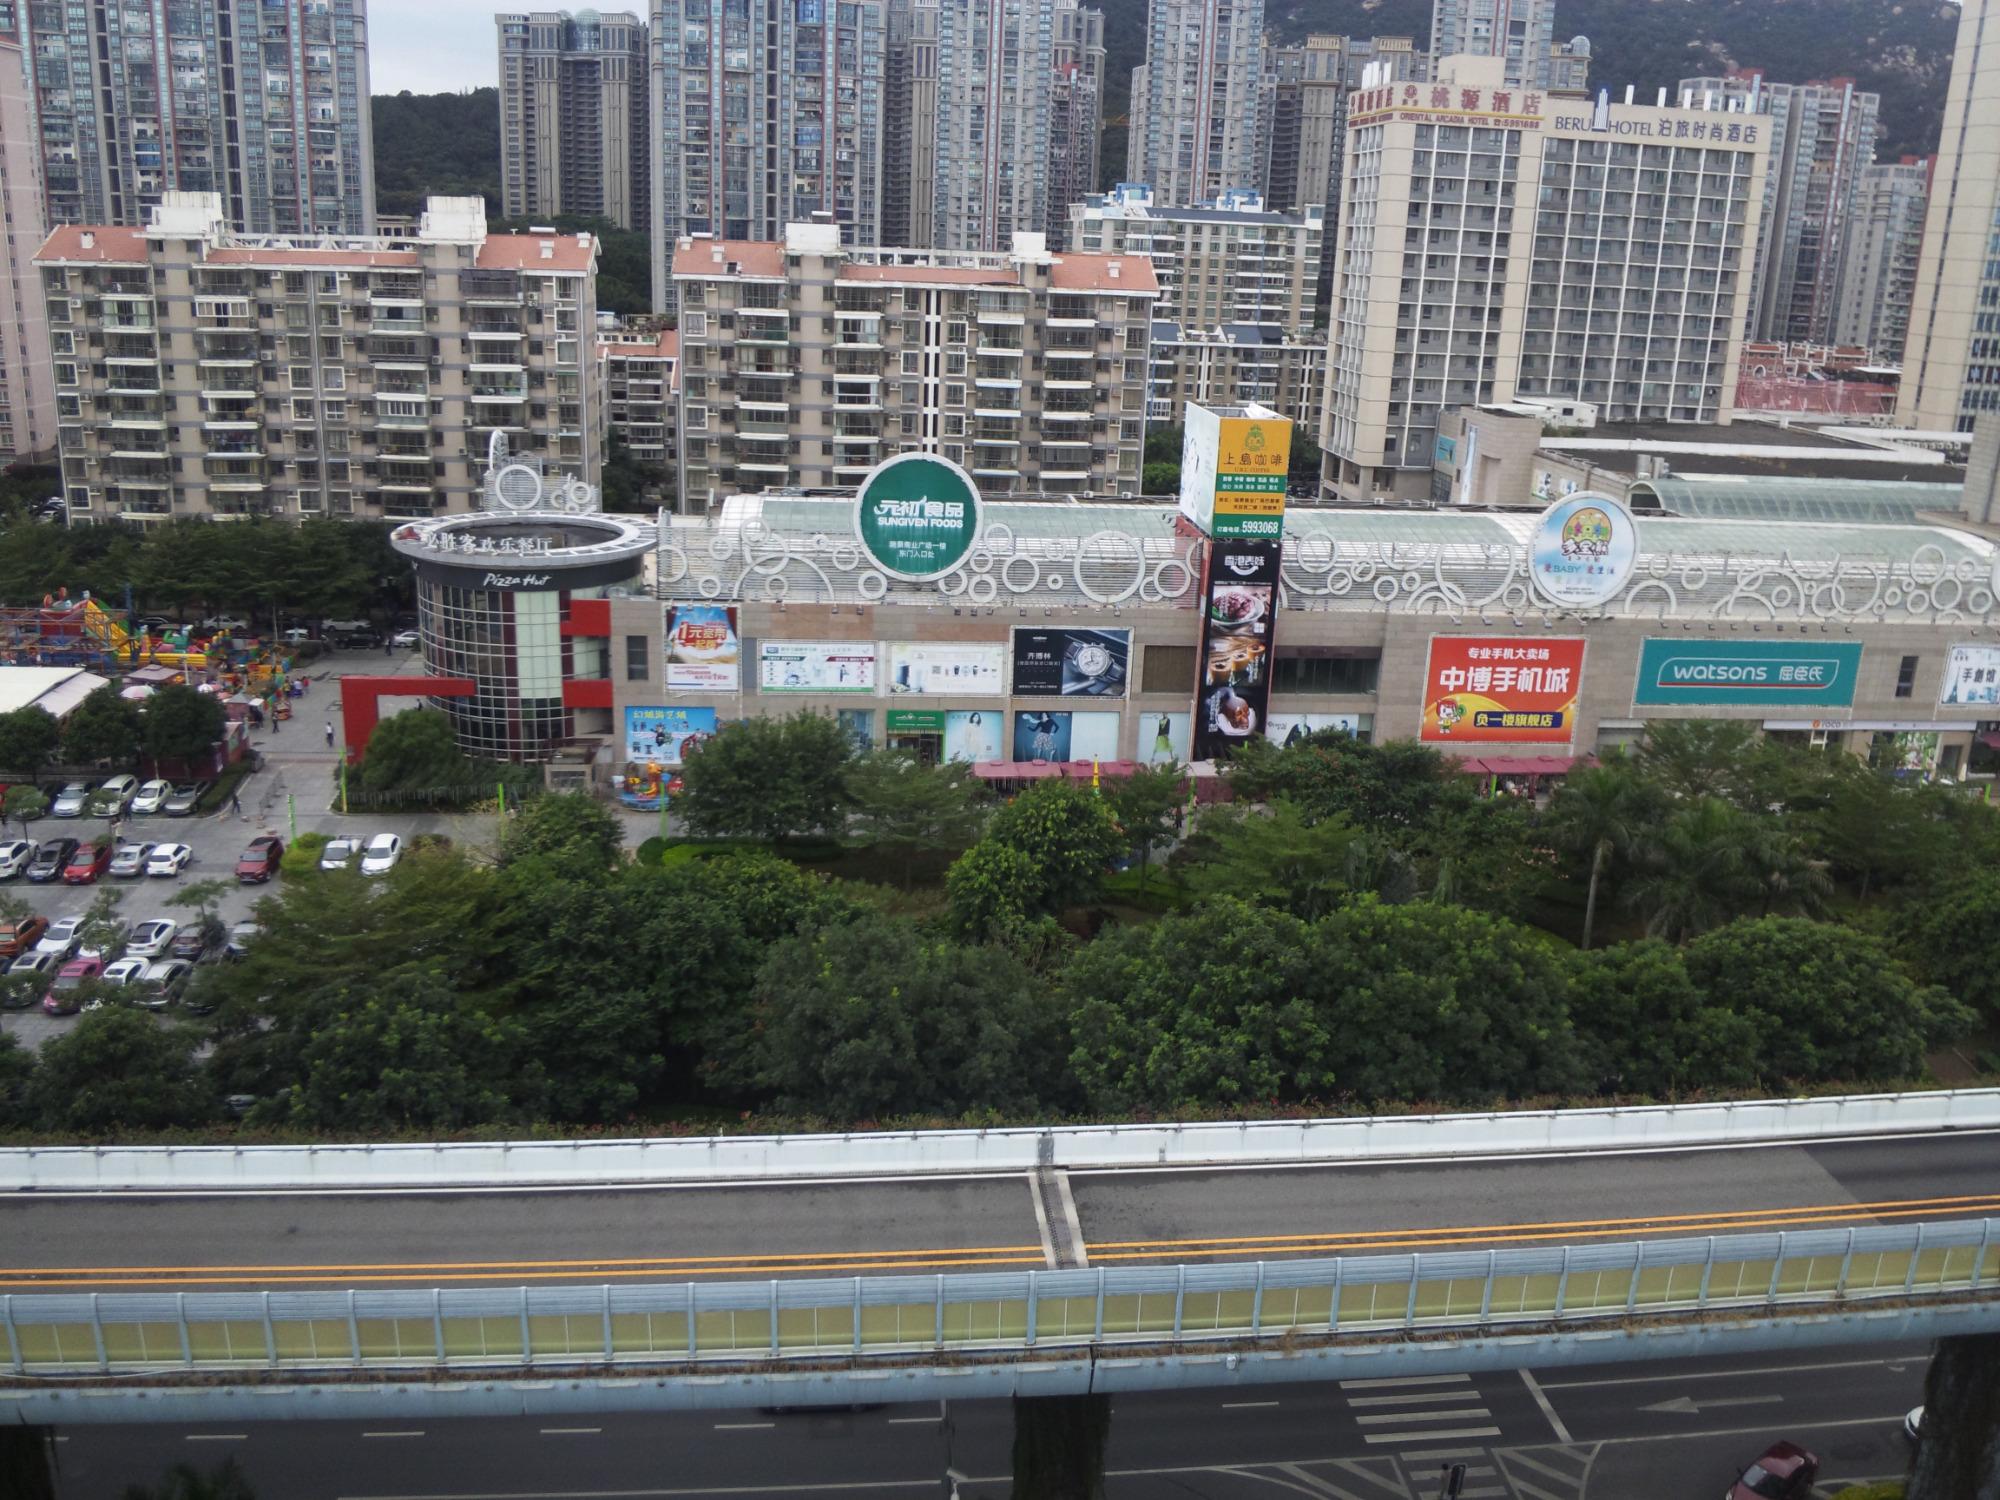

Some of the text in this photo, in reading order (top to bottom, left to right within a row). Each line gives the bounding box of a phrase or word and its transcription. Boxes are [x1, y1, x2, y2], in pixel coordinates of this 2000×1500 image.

[1430, 86, 1542, 116] 桃源酒店
[1400, 111, 1432, 123] ORIENTAL
[1468, 116, 1490, 127] HOTEL
[1607, 119, 1655, 137] HOTEL
[1657, 117, 1759, 144] 泊旅时尚酒店
[873, 495, 964, 518] 元初食品
[877, 516, 964, 529] SUNGIVEN FOODS
[1241, 520, 1279, 534] 5993068
[483, 572, 552, 587] Pizza Hut
[1468, 647, 1550, 661] 专业手机大卖场
[1439, 666, 1571, 693] 中博手机城
[1673, 663, 1824, 682] watsons 屈臣氏
[1475, 713, 1554, 727] 负一楼旗舰店
